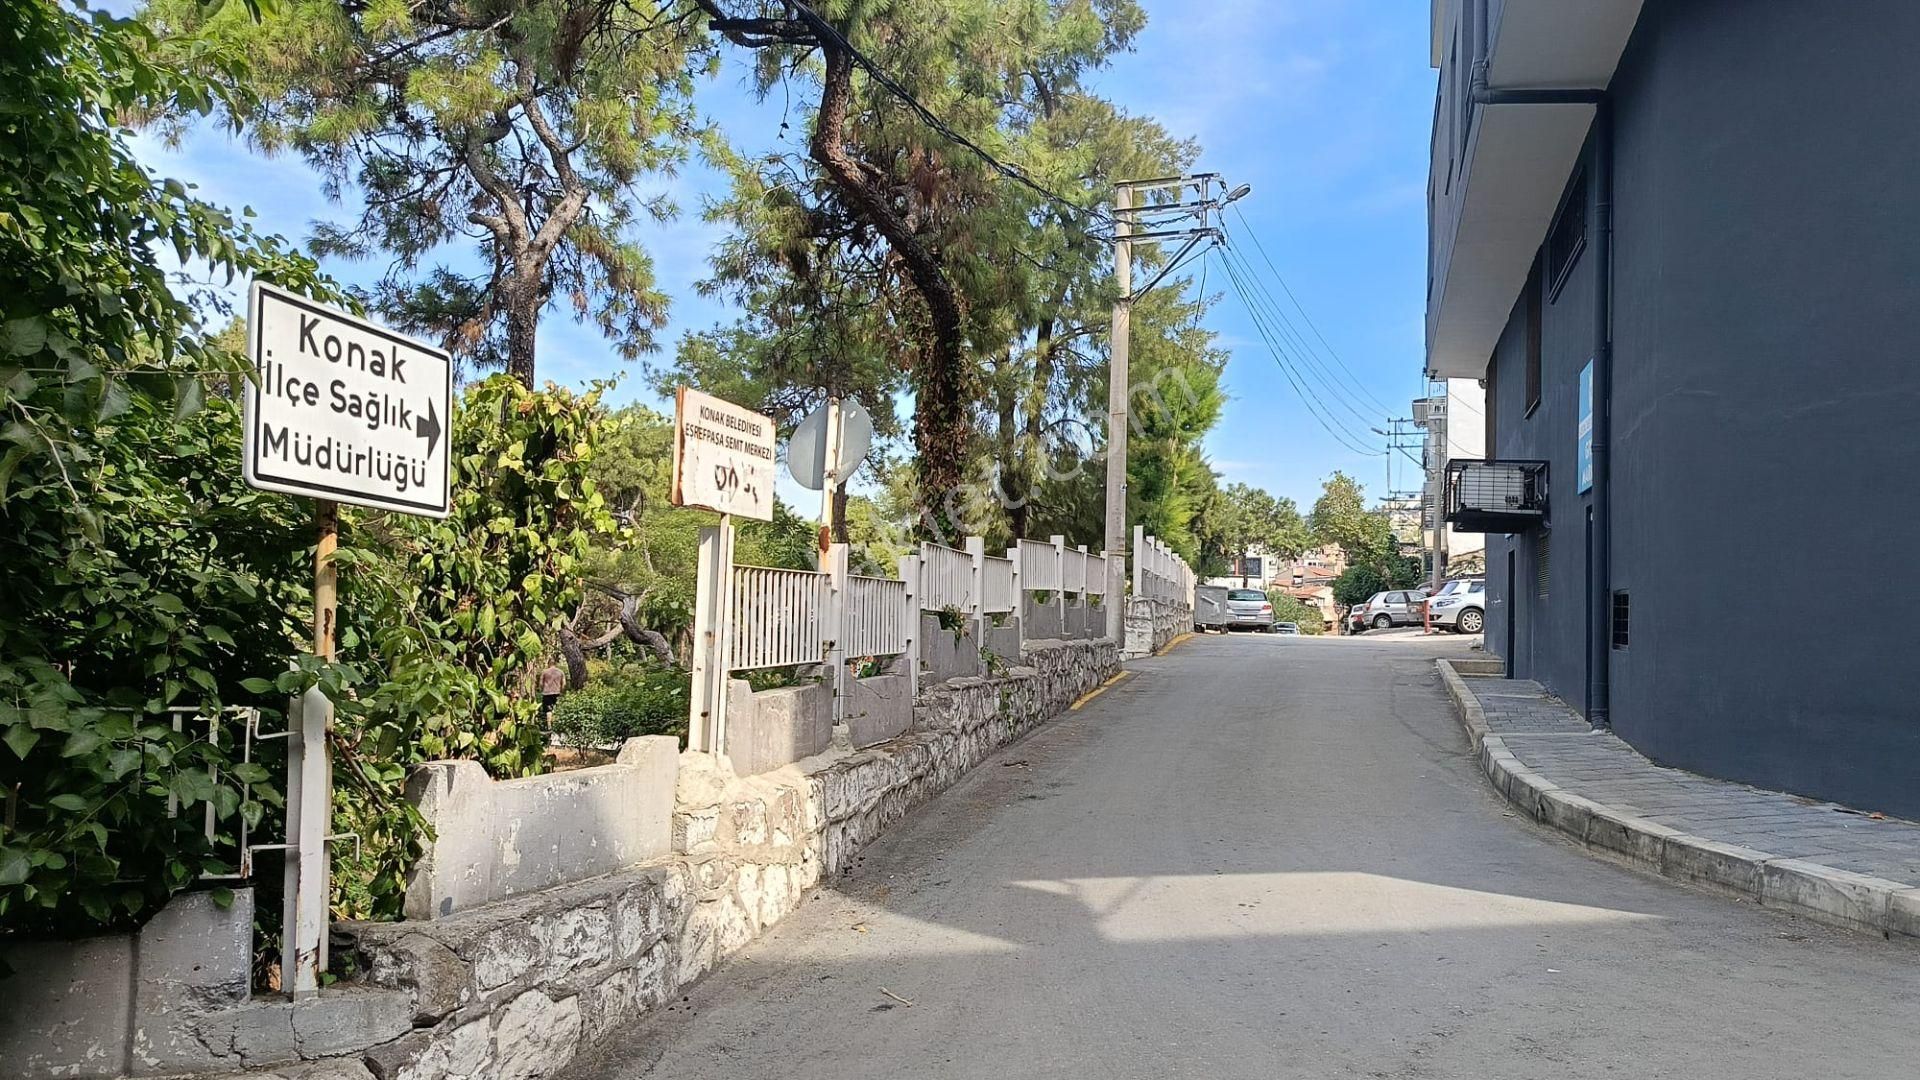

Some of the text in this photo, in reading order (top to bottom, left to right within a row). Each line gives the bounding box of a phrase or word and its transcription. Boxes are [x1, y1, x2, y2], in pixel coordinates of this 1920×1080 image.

[298, 313, 407, 384] Konak
[265, 349, 413, 431] İlçe Sağlık
[699, 404, 725, 424] KONAK
[262, 422, 426, 492] Müdürlüğü
[725, 435, 744, 453] SEMT
